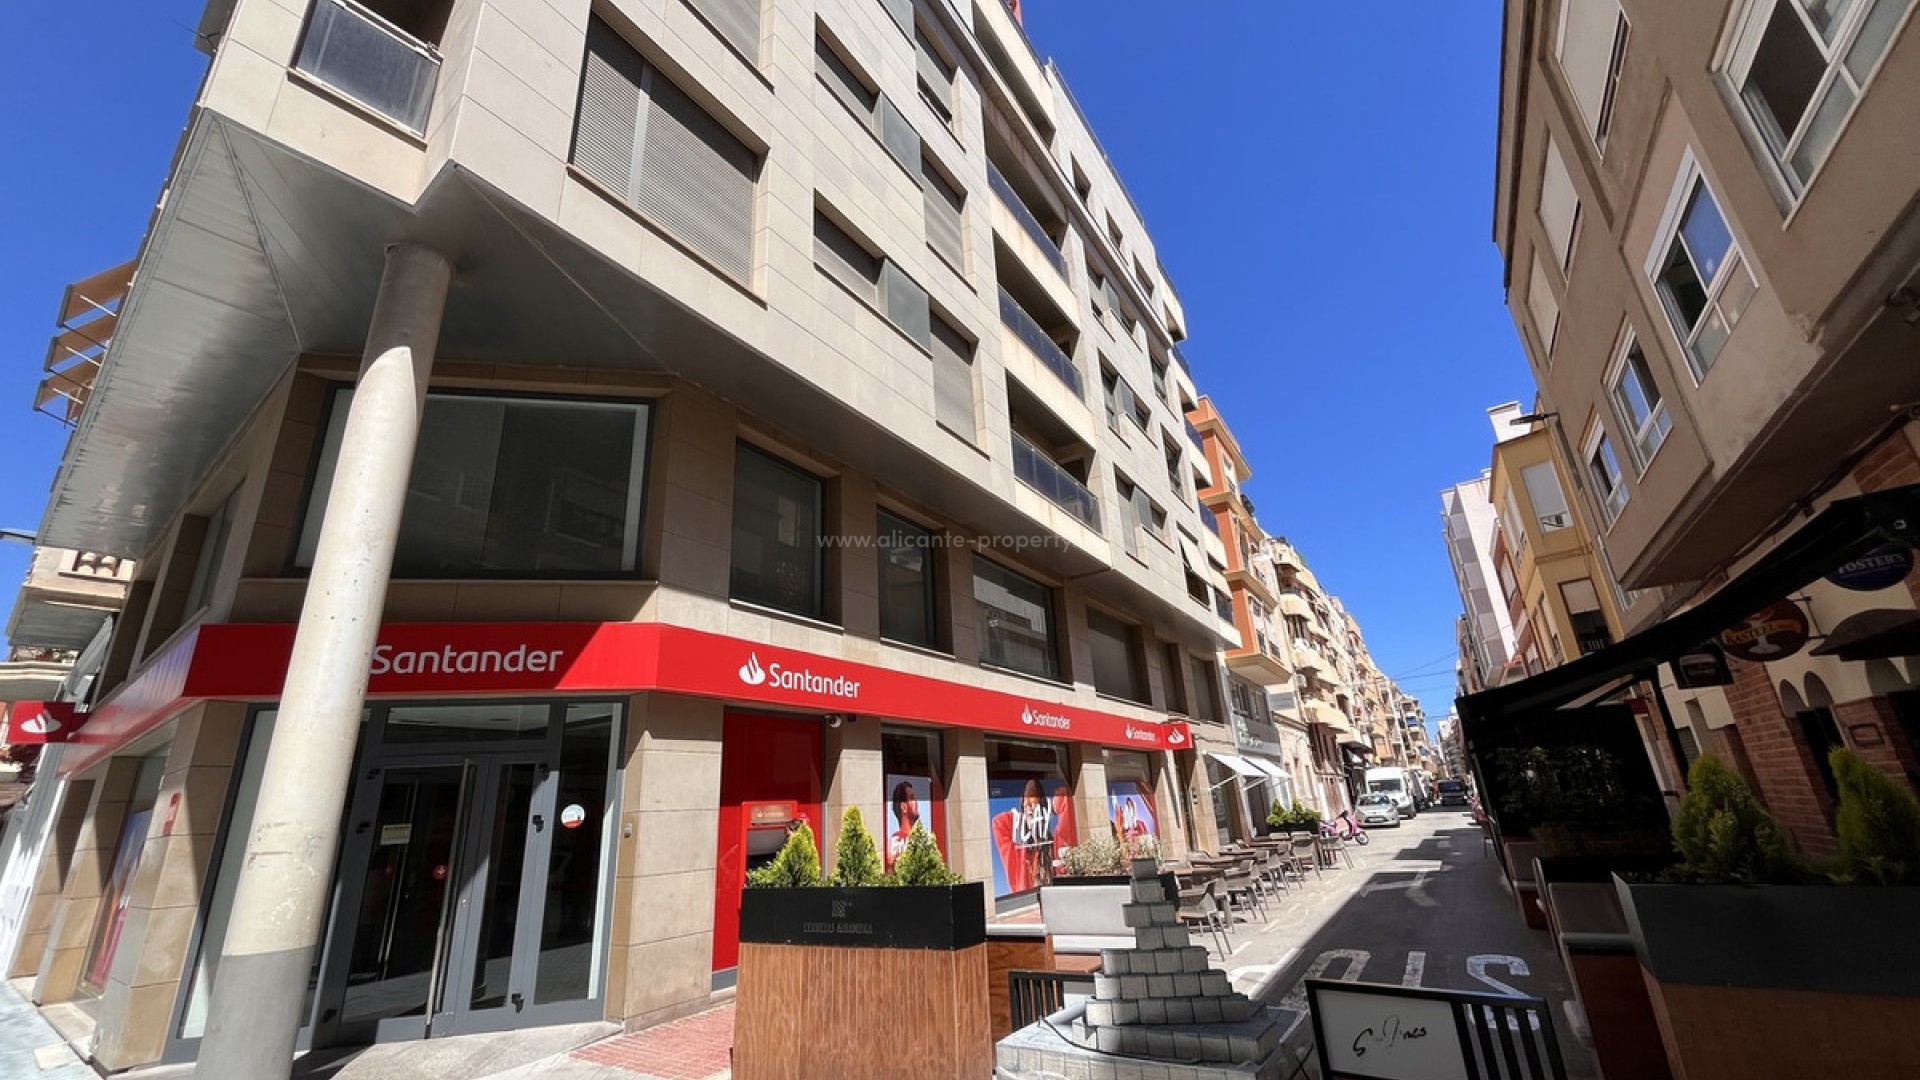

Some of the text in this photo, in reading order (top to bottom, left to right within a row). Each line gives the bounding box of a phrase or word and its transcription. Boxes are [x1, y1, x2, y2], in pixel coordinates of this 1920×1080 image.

[370, 644, 564, 675] Santander
[768, 662, 861, 698] Santander
[1033, 709, 1072, 730] Santander
[1011, 797, 1052, 842] PLAY
